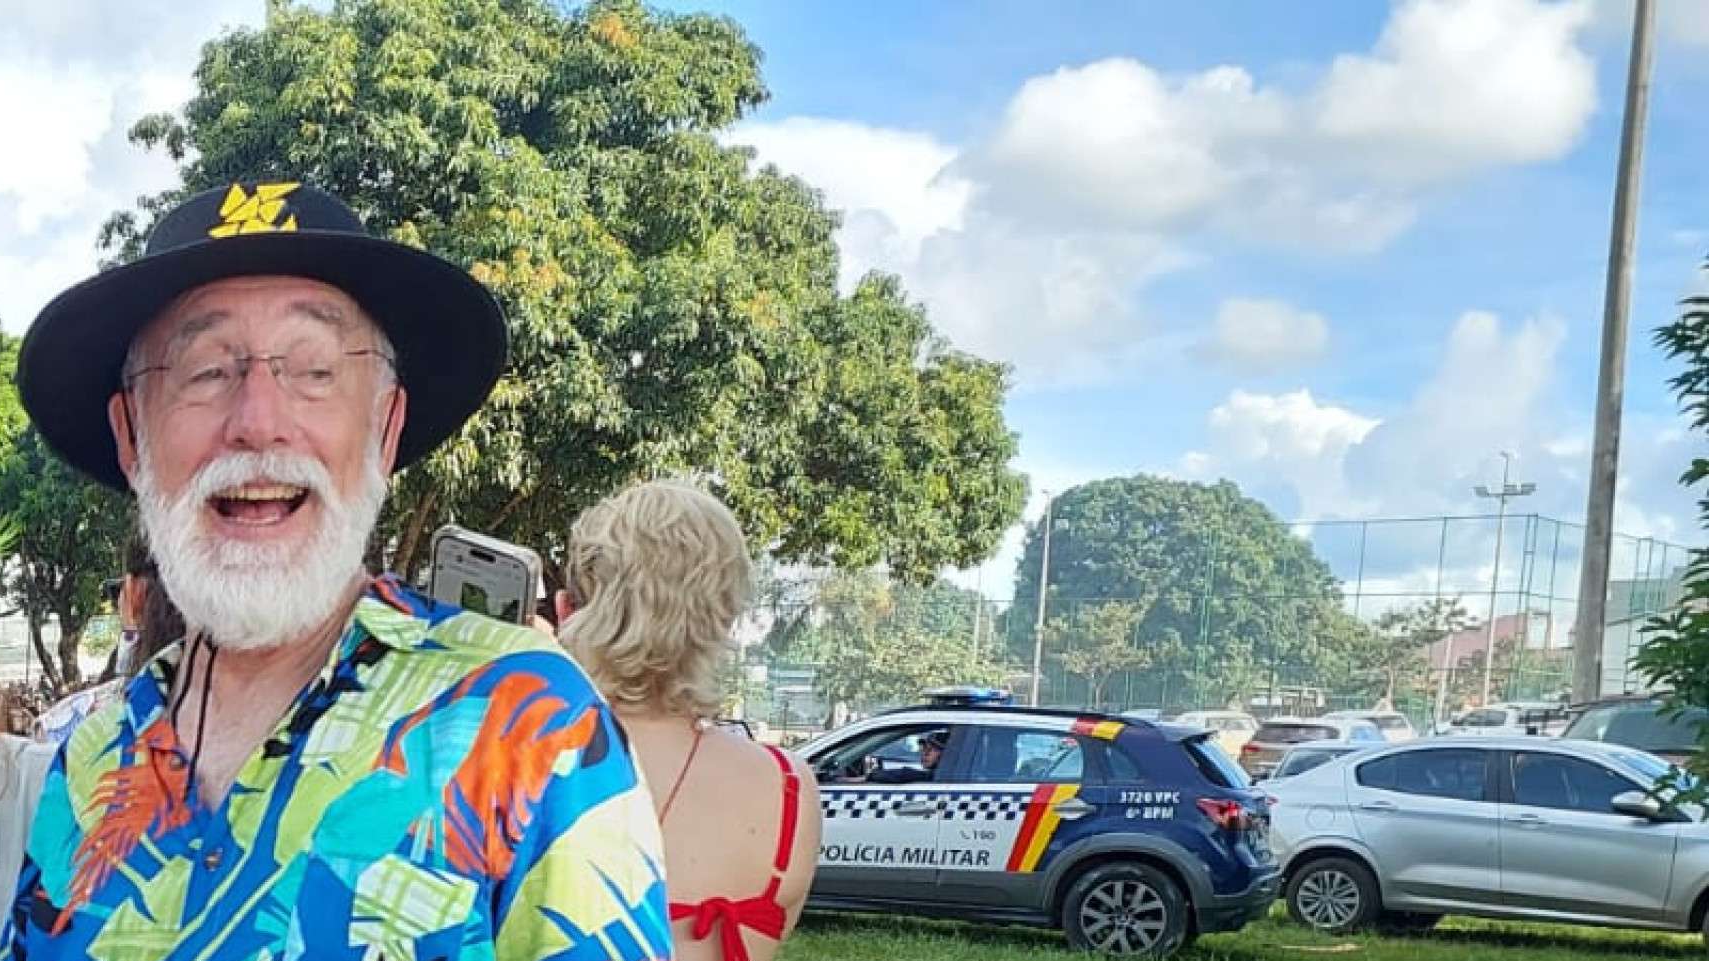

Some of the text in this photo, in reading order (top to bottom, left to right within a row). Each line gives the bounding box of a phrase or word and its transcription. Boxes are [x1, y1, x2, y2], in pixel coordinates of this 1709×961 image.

[1143, 806, 1174, 819] BPM
[974, 830, 997, 840] 190
[901, 847, 990, 866] MILITAR
